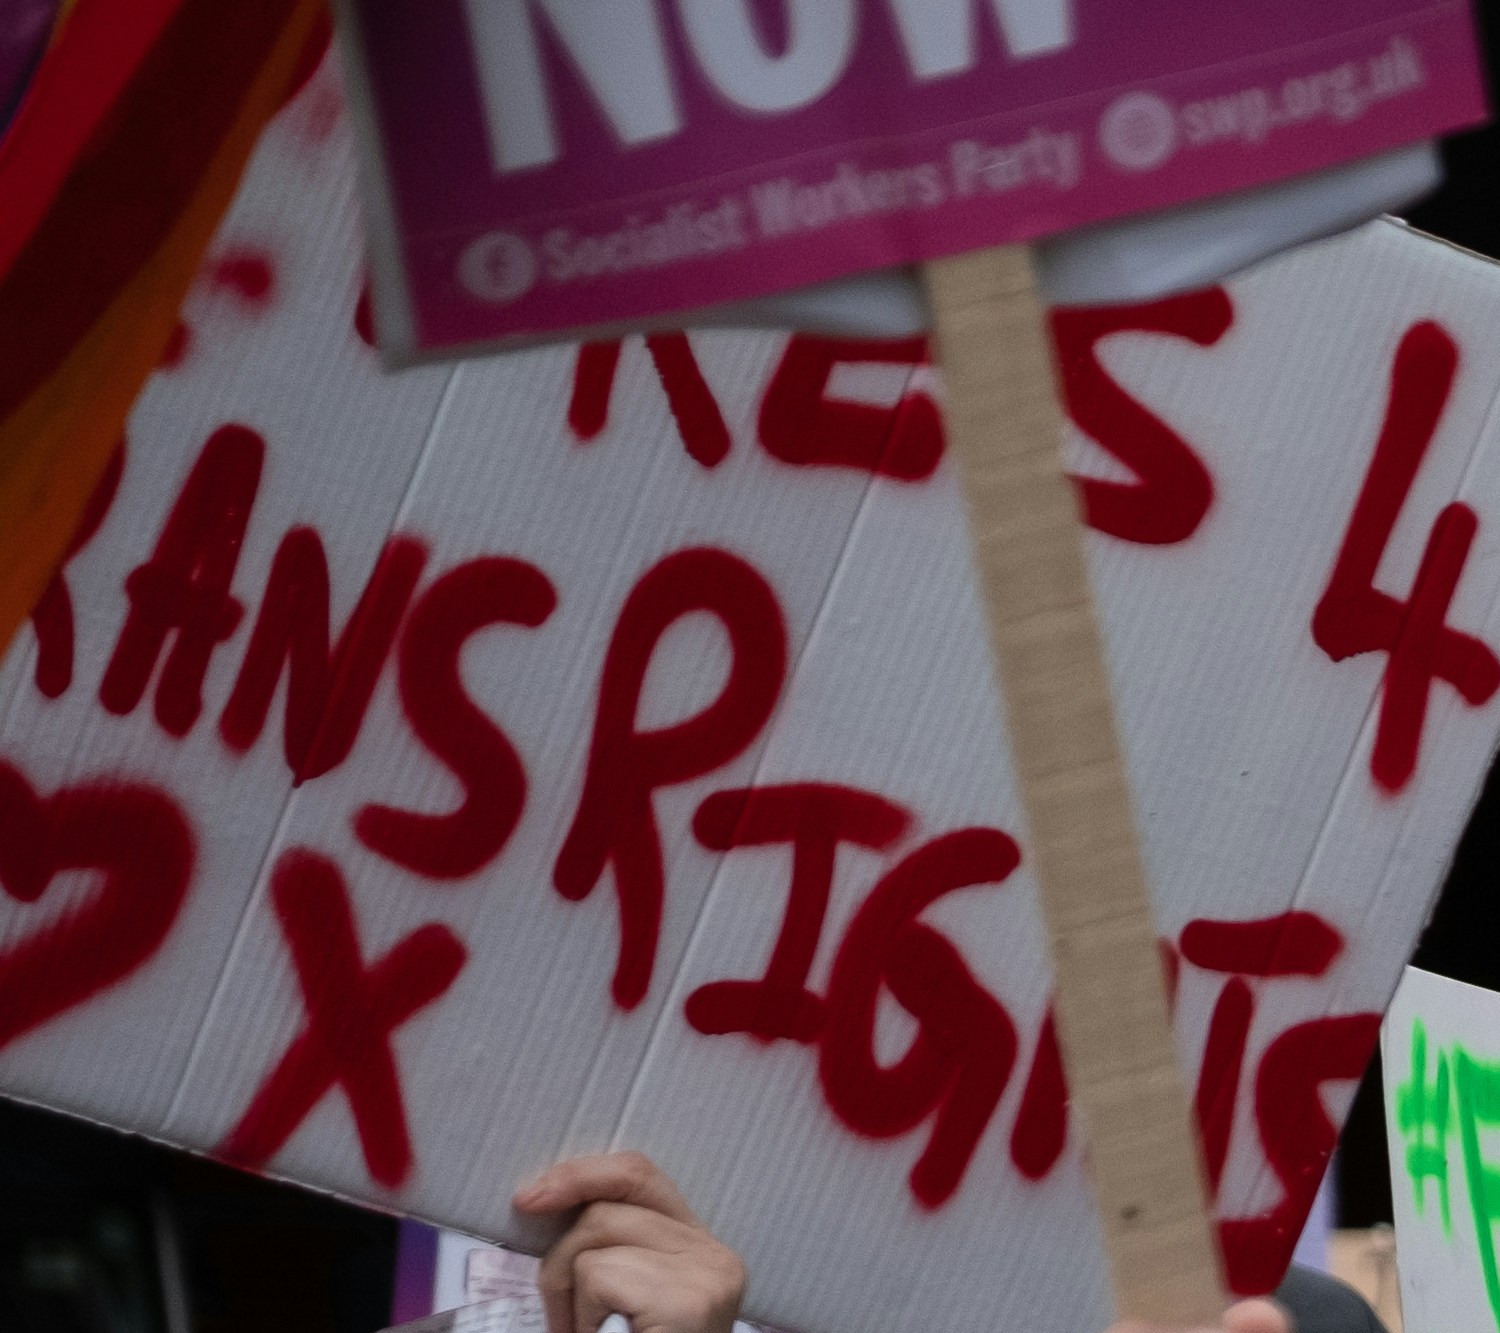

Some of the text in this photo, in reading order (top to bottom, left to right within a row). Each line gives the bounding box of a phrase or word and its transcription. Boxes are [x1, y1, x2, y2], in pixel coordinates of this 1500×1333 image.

[539, 180, 747, 284] Socialist
[749, 148, 942, 240] Workers
[948, 122, 1083, 208] Party
[1183, 38, 1428, 144] swp.org.uk
